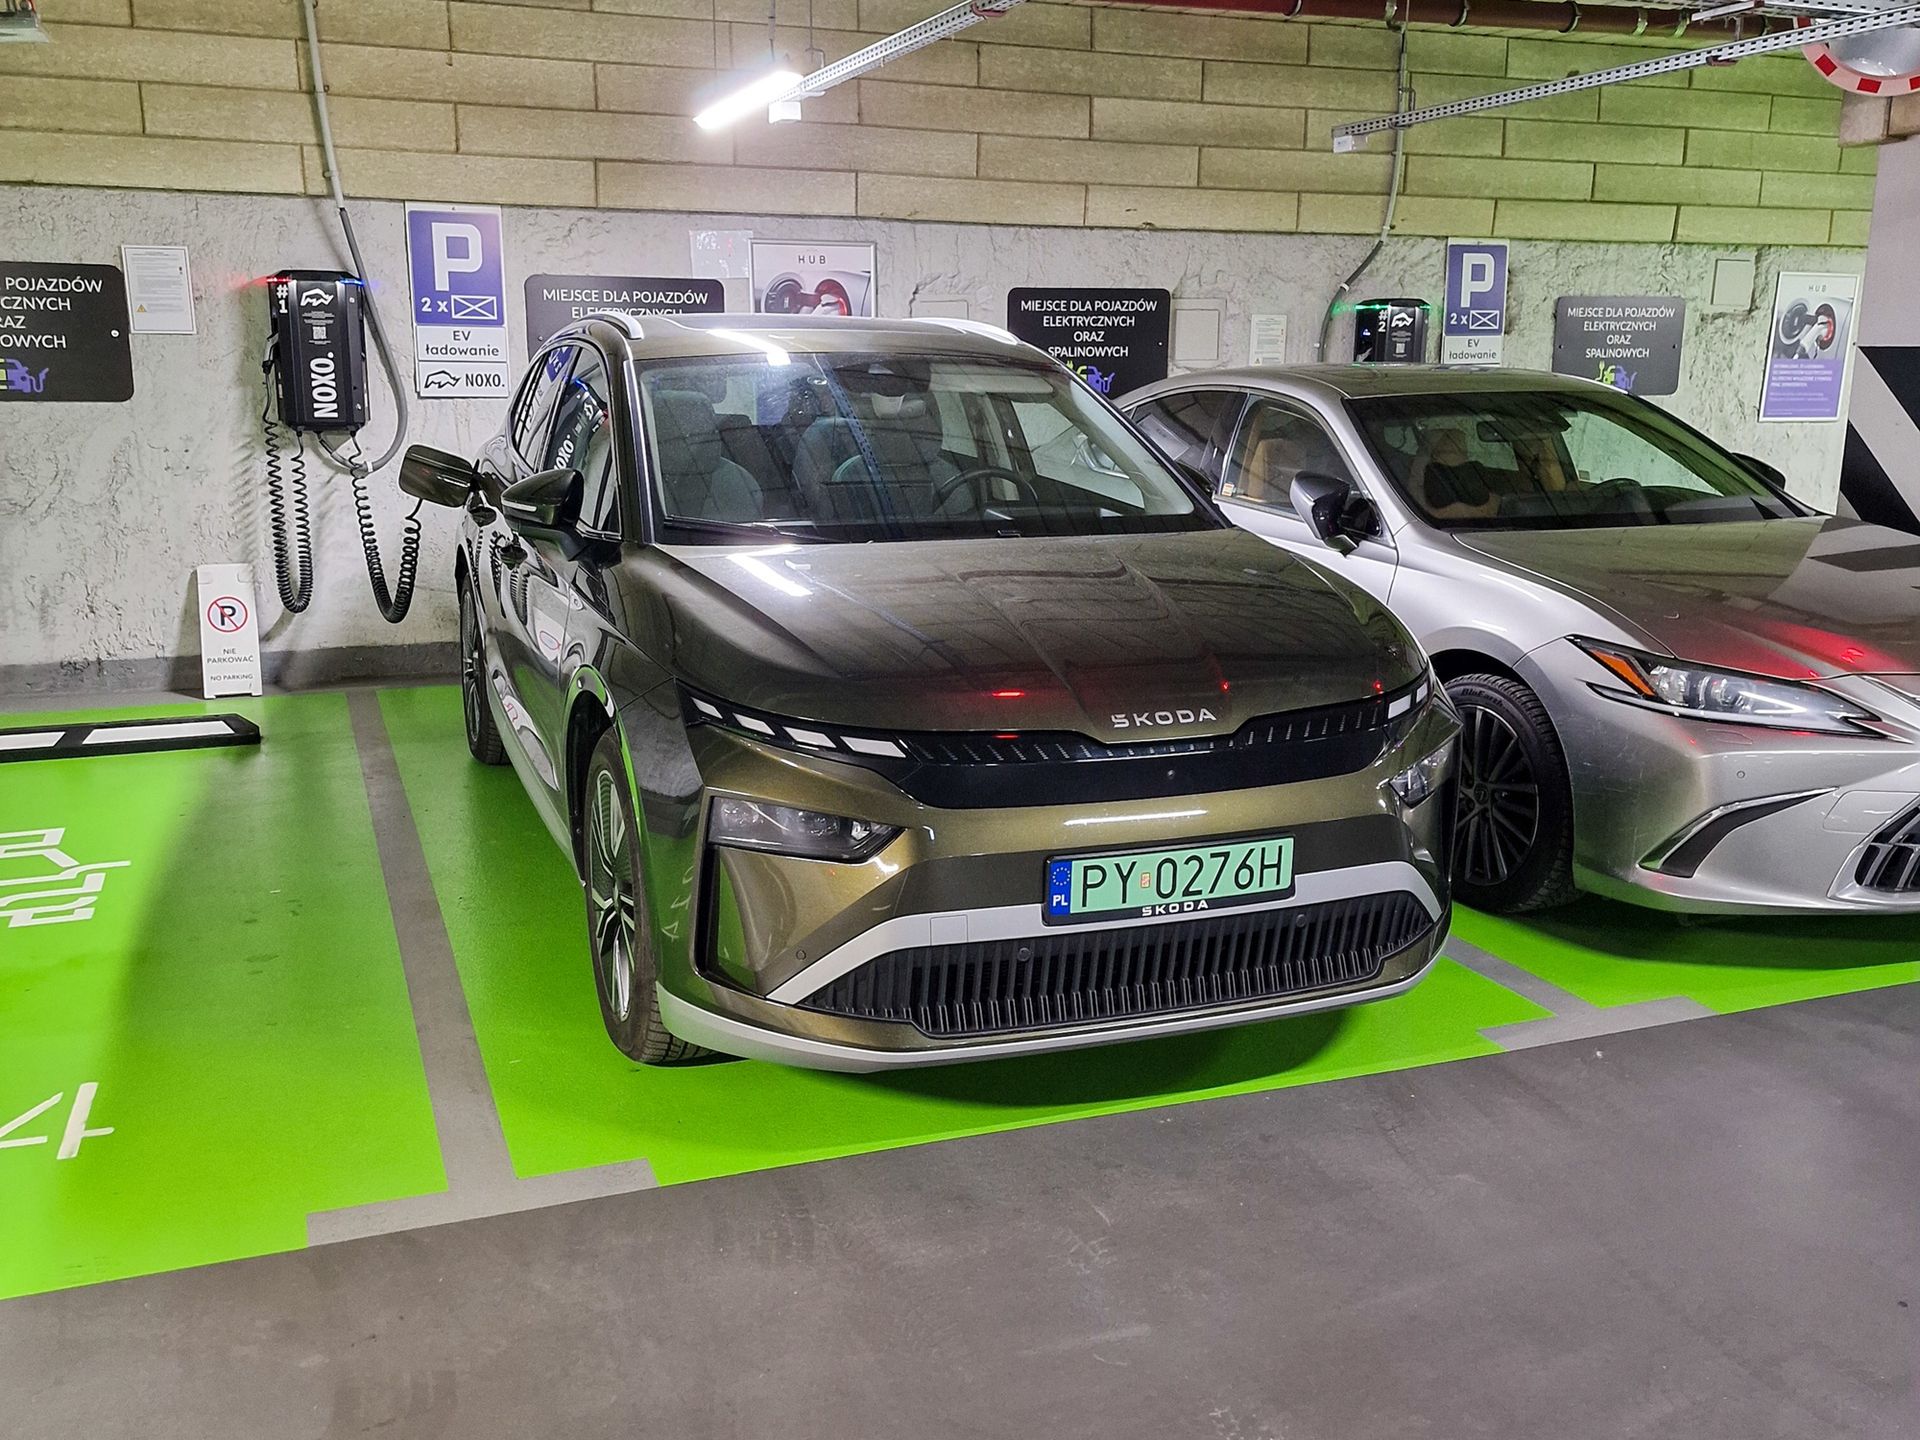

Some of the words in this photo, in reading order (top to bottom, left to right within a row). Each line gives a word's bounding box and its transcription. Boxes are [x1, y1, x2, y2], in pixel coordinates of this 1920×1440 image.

[432, 222, 483, 291] P
[798, 255, 826, 264] HUB
[5, 276, 103, 293] POJAZDÓW
[1460, 253, 1495, 308] P
[543, 289, 599, 302] MIEJSCE
[603, 290, 630, 303] DLA
[633, 289, 708, 305] POJAZDÓW
[279, 300, 288, 313] 1
[421, 297, 432, 313] 2
[437, 300, 449, 313] x
[1021, 300, 1067, 312] MIEJSCE
[1070, 300, 1093, 312] DLA
[1095, 298, 1157, 312] POJAZDÓW
[1568, 307, 1604, 317] MIEJSCE
[1605, 307, 1623, 317] DLA
[1625, 305, 1675, 318] POJAZDÓW
[1043, 315, 1135, 327] ELEKTRYCZNYCH
[1450, 313, 1458, 325] 2
[1460, 315, 1468, 325] x
[1378, 321, 1387, 333] 2
[1584, 321, 1657, 332] ELEKTRYCZNYCH
[453, 331, 471, 341] EV
[1073, 331, 1105, 342] ORAZ
[1606, 335, 1632, 345] ORAZ
[1467, 339, 1480, 348] EV
[426, 345, 500, 357] ładowanie
[1048, 346, 1129, 358] SPALINOWYCH
[1449, 350, 1497, 360] ładowanie
[1585, 348, 1650, 359] SPALINOWYCH
[310, 352, 339, 418] NOXO.
[465, 373, 505, 388] NOXO.
[207, 655, 254, 664] PARKOWAĆ
[223, 673, 254, 681] PARKING
[1111, 708, 1216, 728] SKODA
[1081, 861, 1137, 908] PY
[1155, 845, 1283, 899] 0276H
[1053, 894, 1069, 907] PL
[1142, 899, 1208, 917] SKODA
